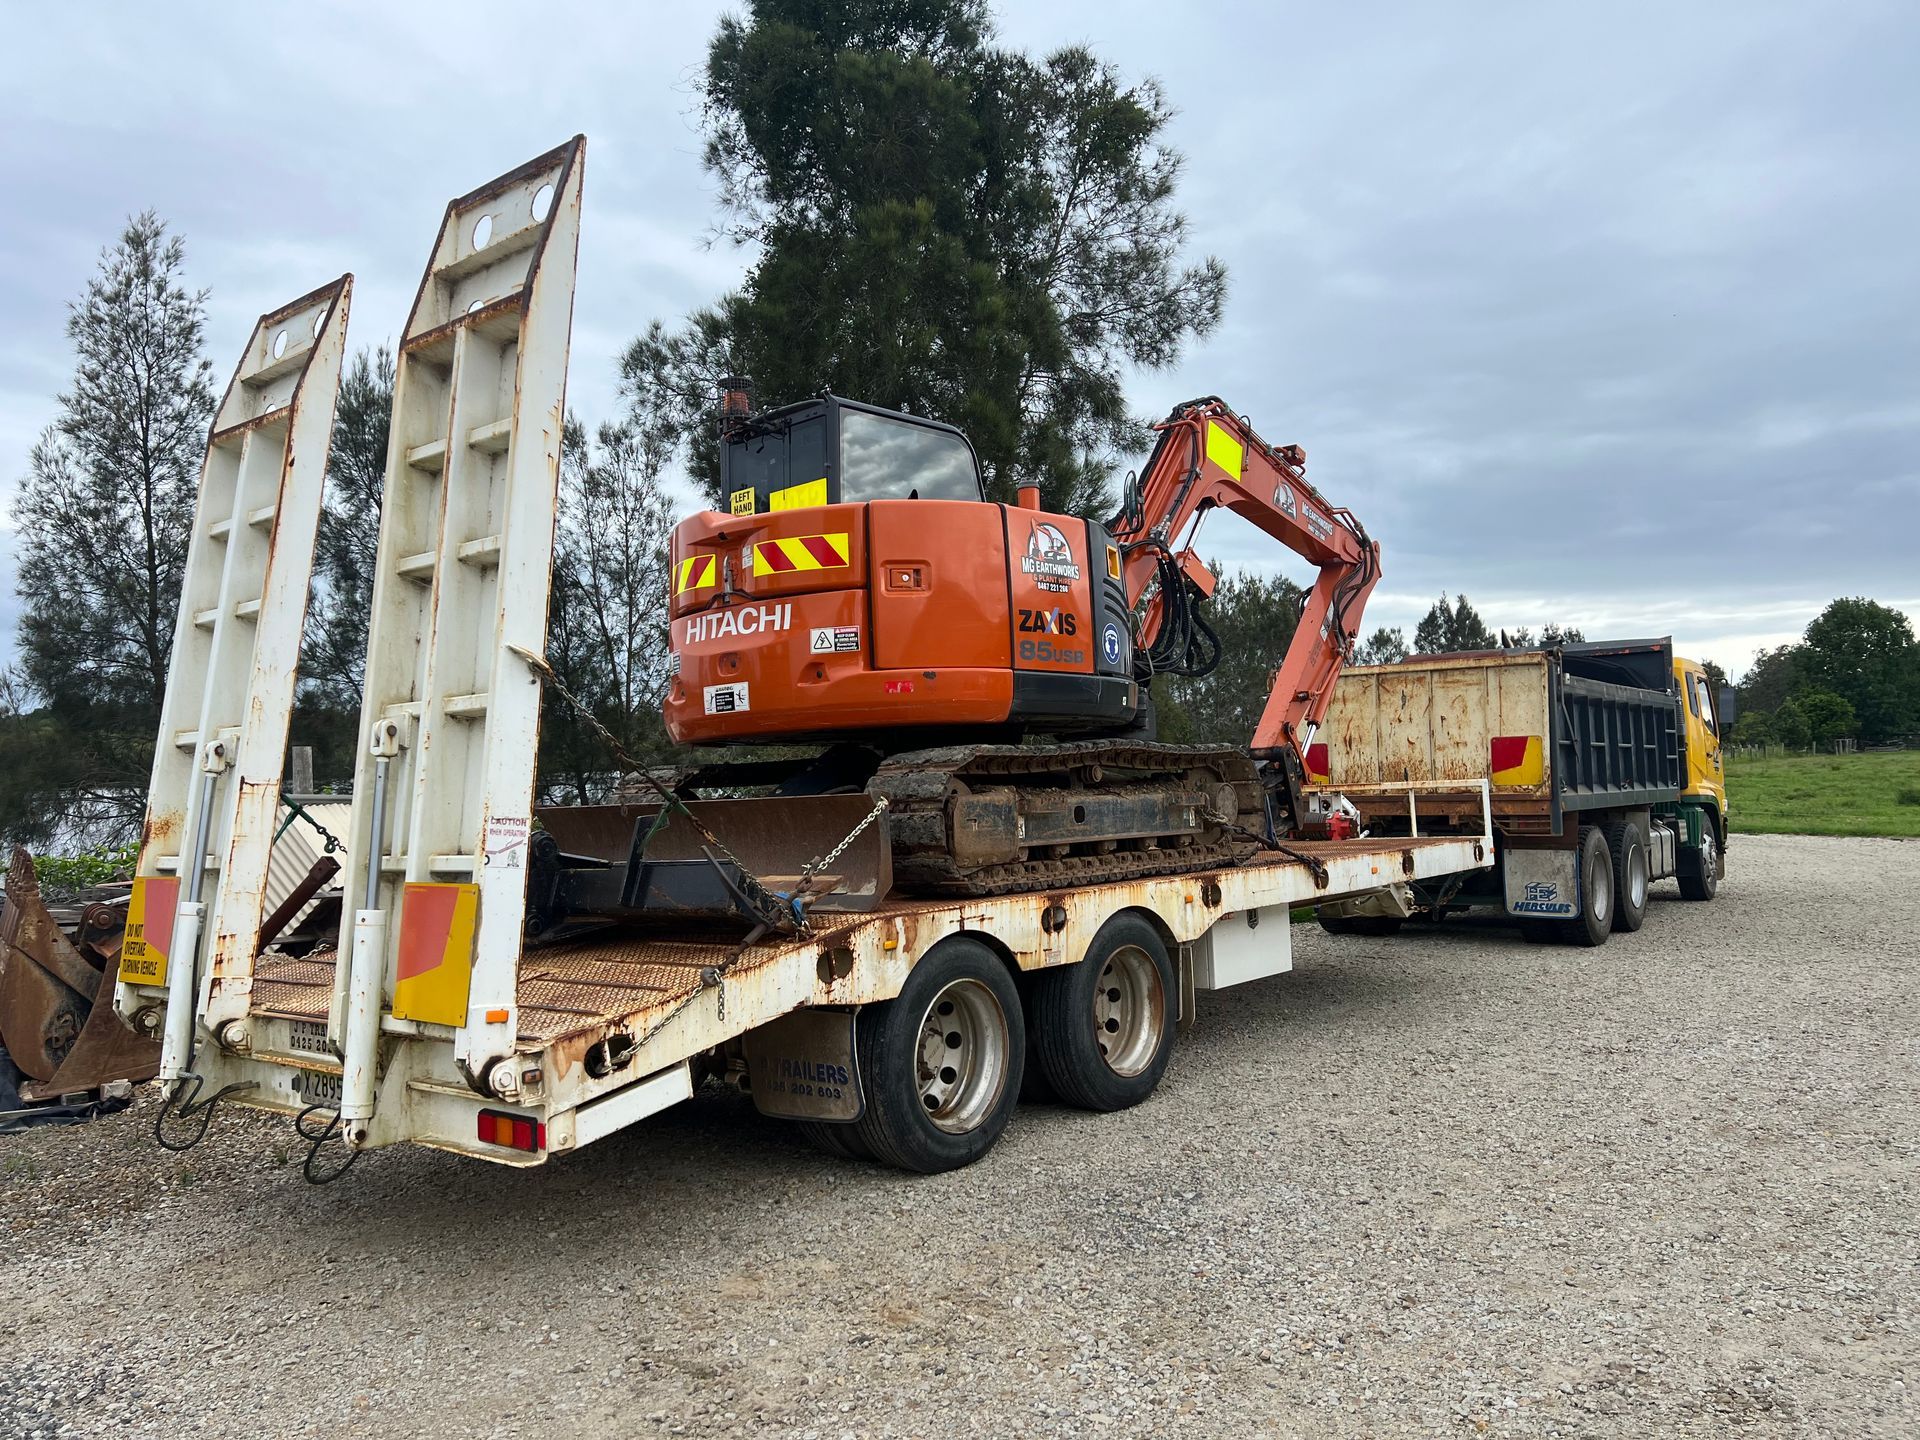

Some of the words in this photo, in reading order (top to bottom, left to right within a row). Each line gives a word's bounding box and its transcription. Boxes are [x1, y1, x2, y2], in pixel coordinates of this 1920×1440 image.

[734, 491, 751, 504] LEFT
[733, 502, 753, 515] HAND
[1021, 556, 1035, 573] MG
[1035, 560, 1079, 580] EARTHWORKS
[1038, 574, 1058, 584] PLANT
[1058, 578, 1072, 586] HIRE
[685, 603, 793, 645] HITACHI
[1018, 607, 1077, 636] ZAXIS
[490, 816, 527, 827] CAUTION
[1513, 901, 1572, 913] HERCULES
[127, 923, 135, 937] DO
[134, 923, 144, 938] NOT
[124, 941, 147, 957] OVERTAKE
[122, 958, 140, 975] TURNING
[140, 960, 158, 976] VEHICLE
[309, 1023, 328, 1037] TRA
[290, 1035, 312, 1050] 0425
